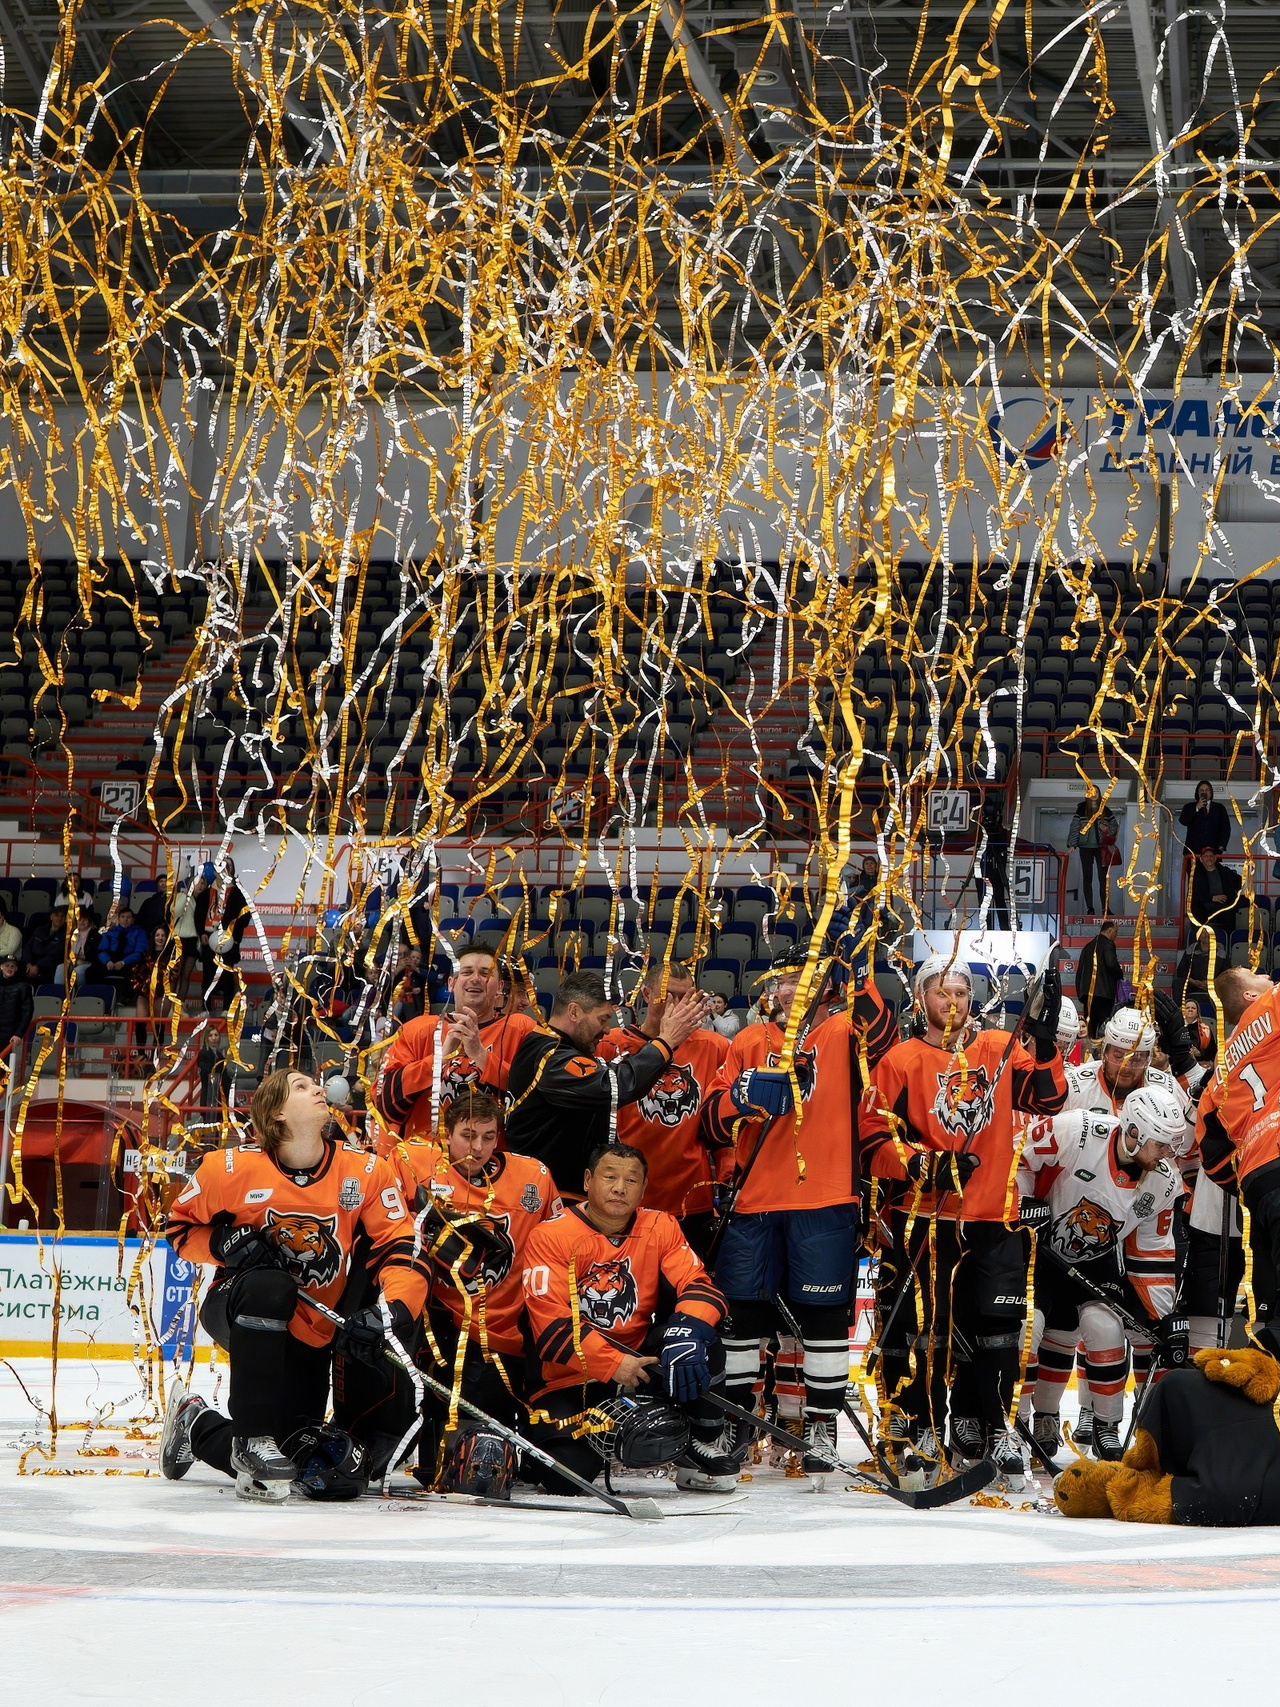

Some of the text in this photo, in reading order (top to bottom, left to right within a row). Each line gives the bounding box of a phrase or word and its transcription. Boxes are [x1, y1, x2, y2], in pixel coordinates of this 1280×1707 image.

[933, 796, 963, 824] 24
[1239, 1062, 1269, 1113] 1
[801, 1283, 842, 1293] BAUER
